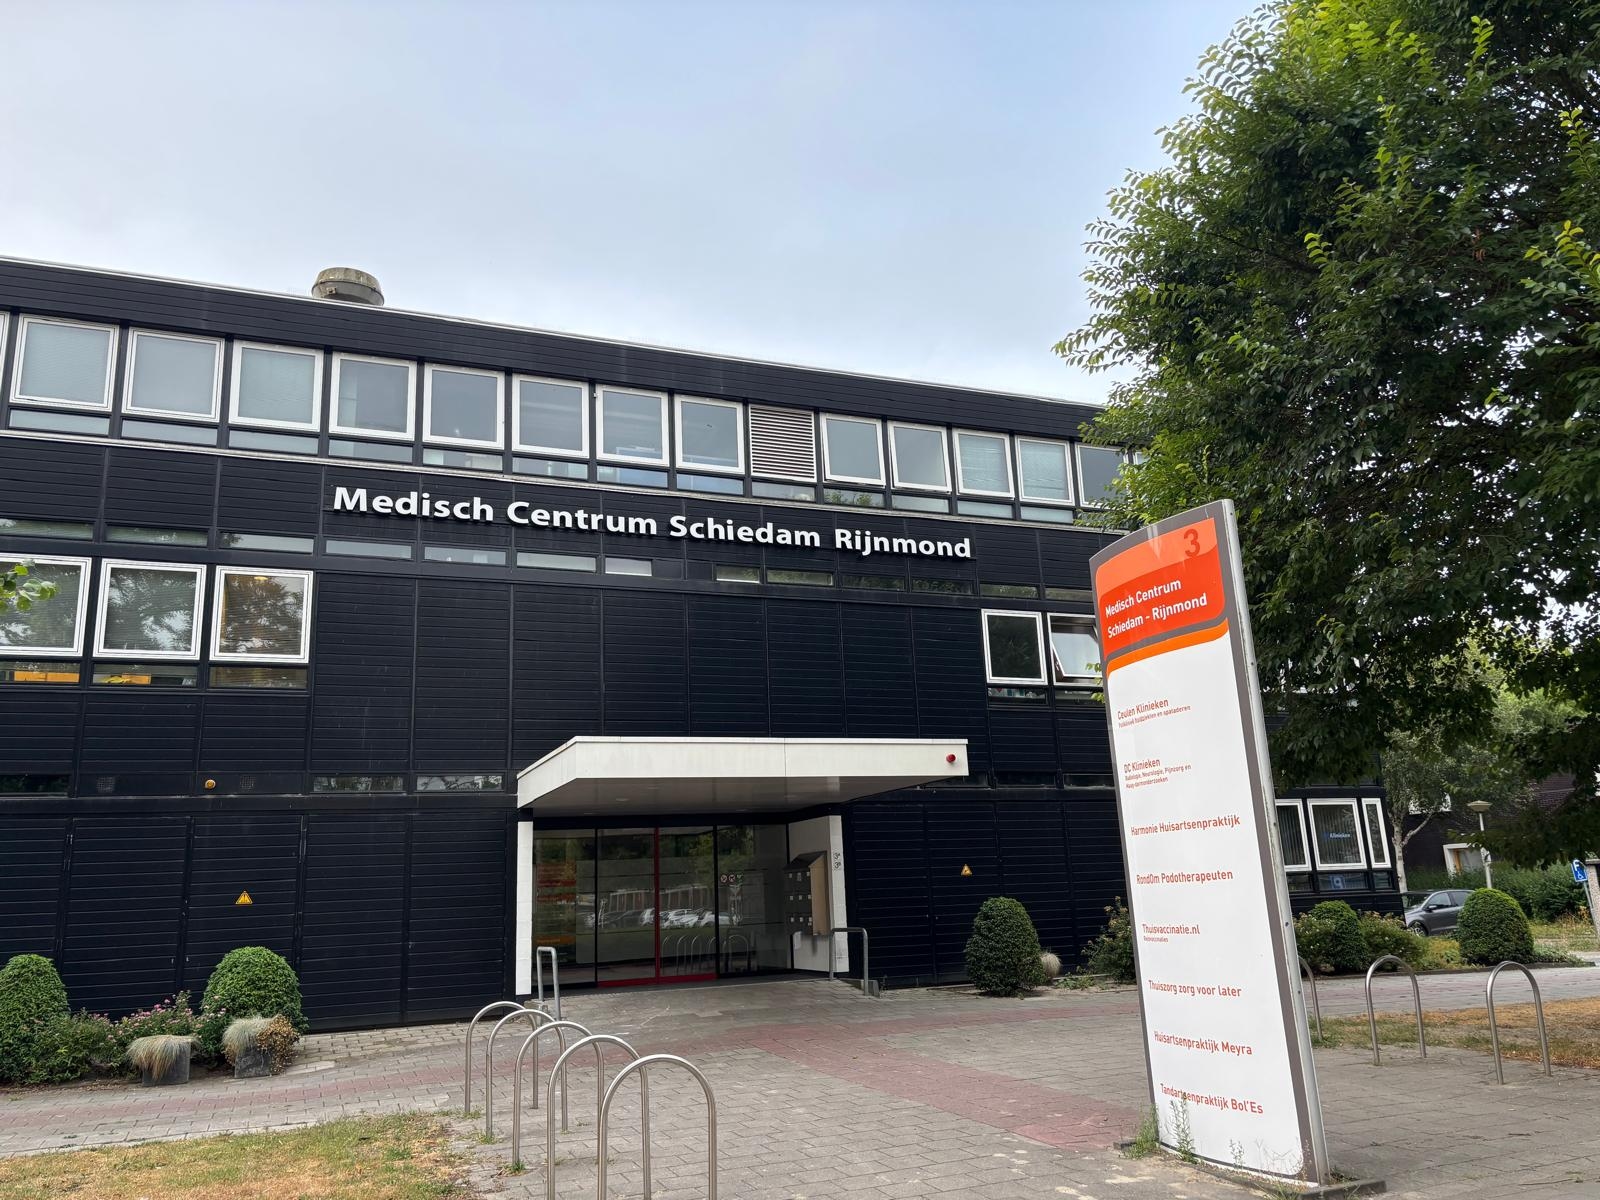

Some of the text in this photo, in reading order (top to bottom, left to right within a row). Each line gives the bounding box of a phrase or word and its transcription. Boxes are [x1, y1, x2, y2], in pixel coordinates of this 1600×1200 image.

[333, 485, 971, 559] Medisch Centrum Schiedam Rijnmond
[1183, 528, 1201, 557] 3
[1105, 579, 1182, 618] Medisch Centrum
[1107, 614, 1144, 638] Schiedam
[1152, 593, 1208, 621] Rijnmond
[1136, 699, 1169, 714] Klinieken
[1132, 759, 1161, 772] Klinieken
[1131, 814, 1241, 836] Harmonie Huisartsenpraktijk
[1136, 869, 1234, 885] RondOm Podotherapeuten
[1142, 923, 1200, 935] Thuisvaccinatie.nl
[1148, 980, 1242, 997] Thuiszorg zorg voor later
[1154, 1030, 1253, 1057] Huisartsenpraktijk Meyra
[1231, 1098, 1264, 1114] Bol'Es
